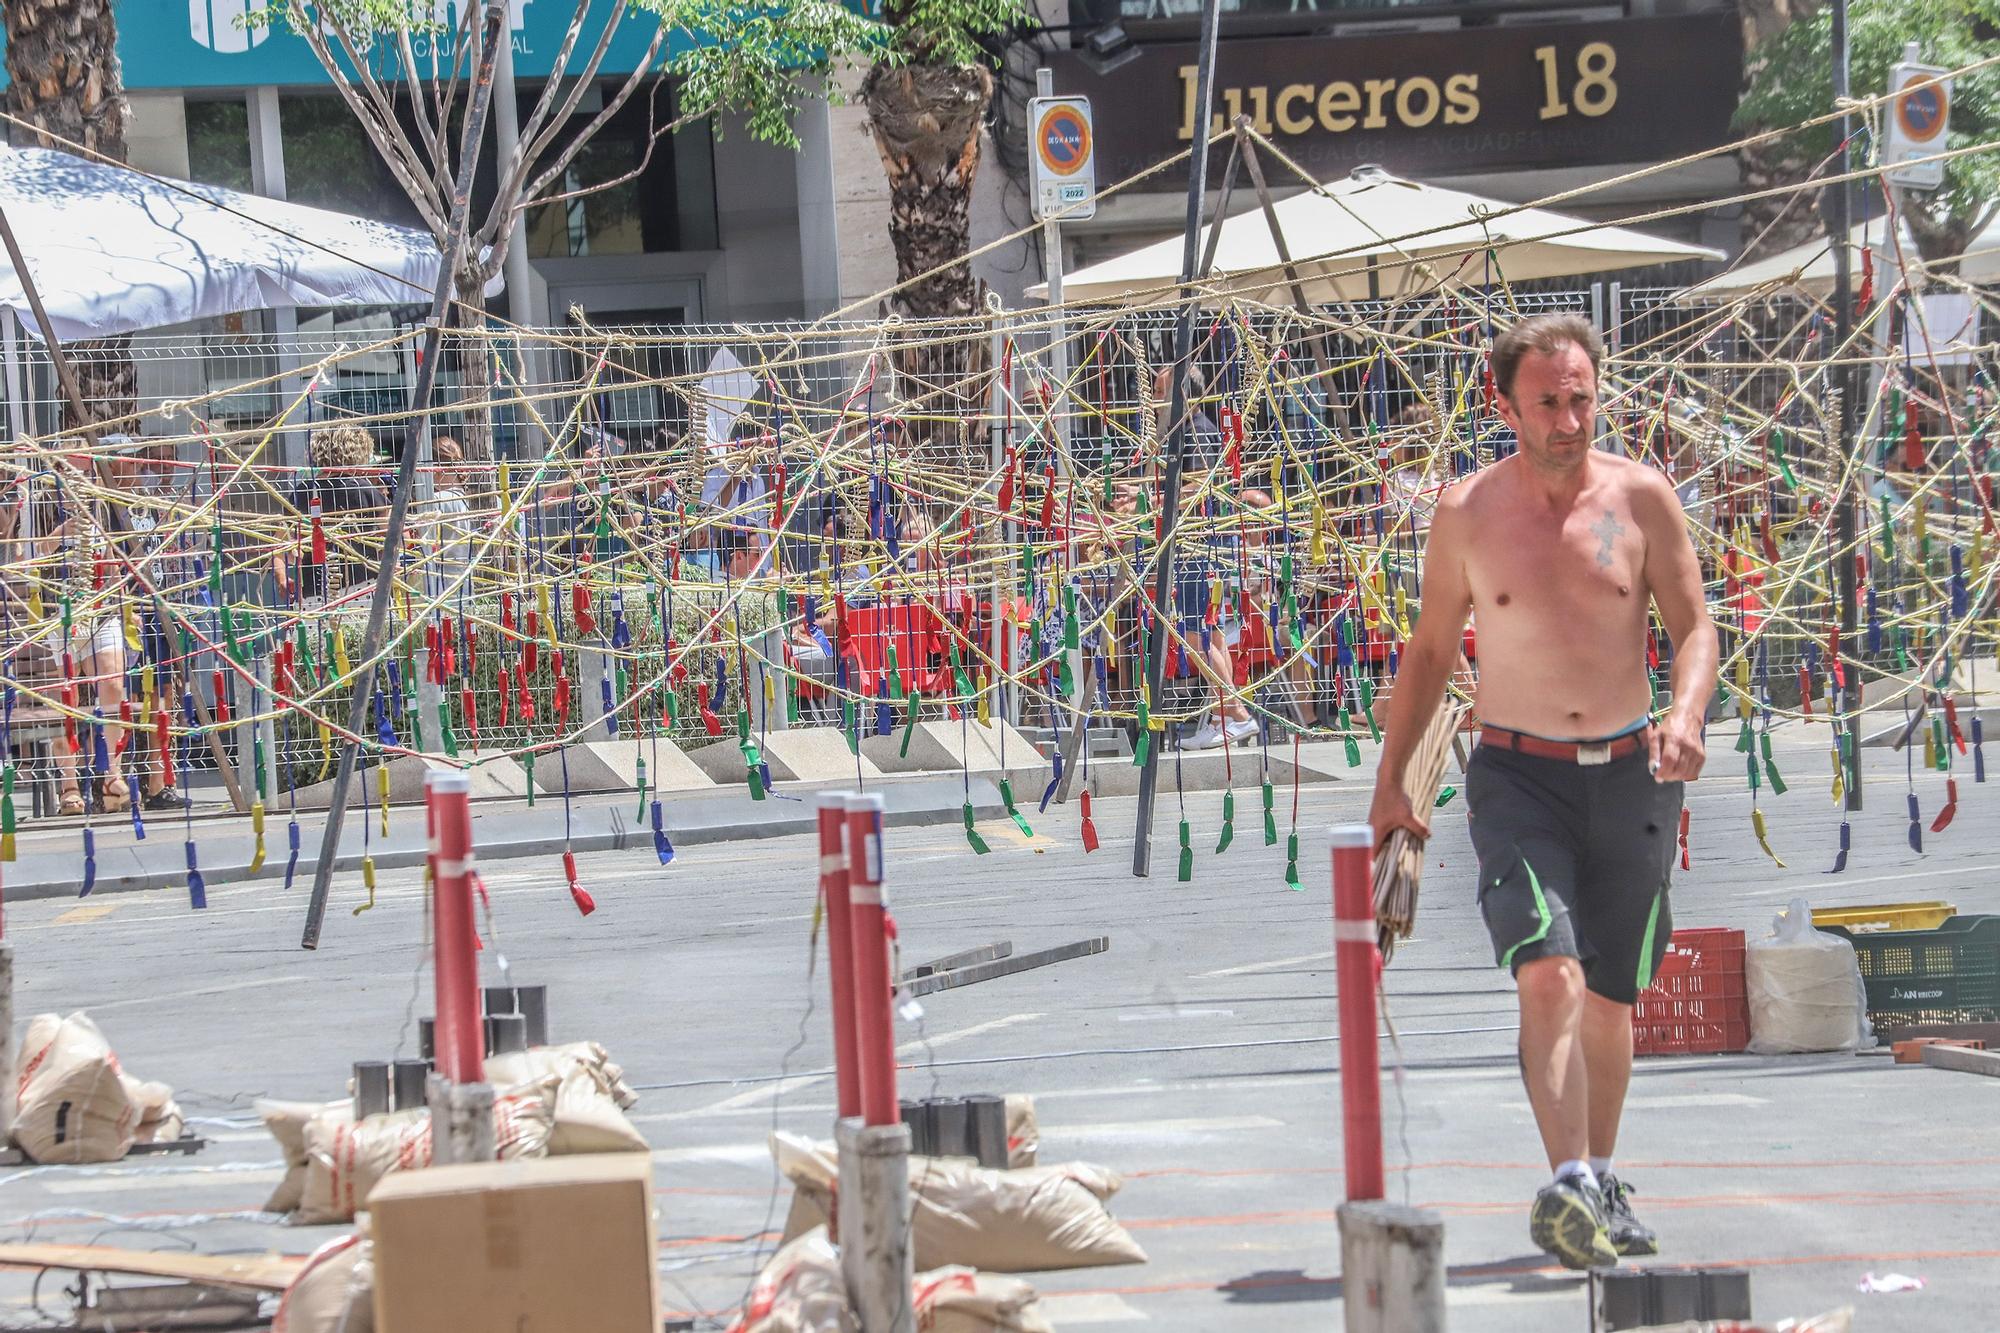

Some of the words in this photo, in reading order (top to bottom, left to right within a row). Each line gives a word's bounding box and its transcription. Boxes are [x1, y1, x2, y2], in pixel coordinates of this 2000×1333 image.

[413, 38, 459, 58] CAJ
[1177, 65, 1480, 140] Luceros
[1534, 41, 1619, 120] 18
[1065, 189, 1084, 198] 2022
